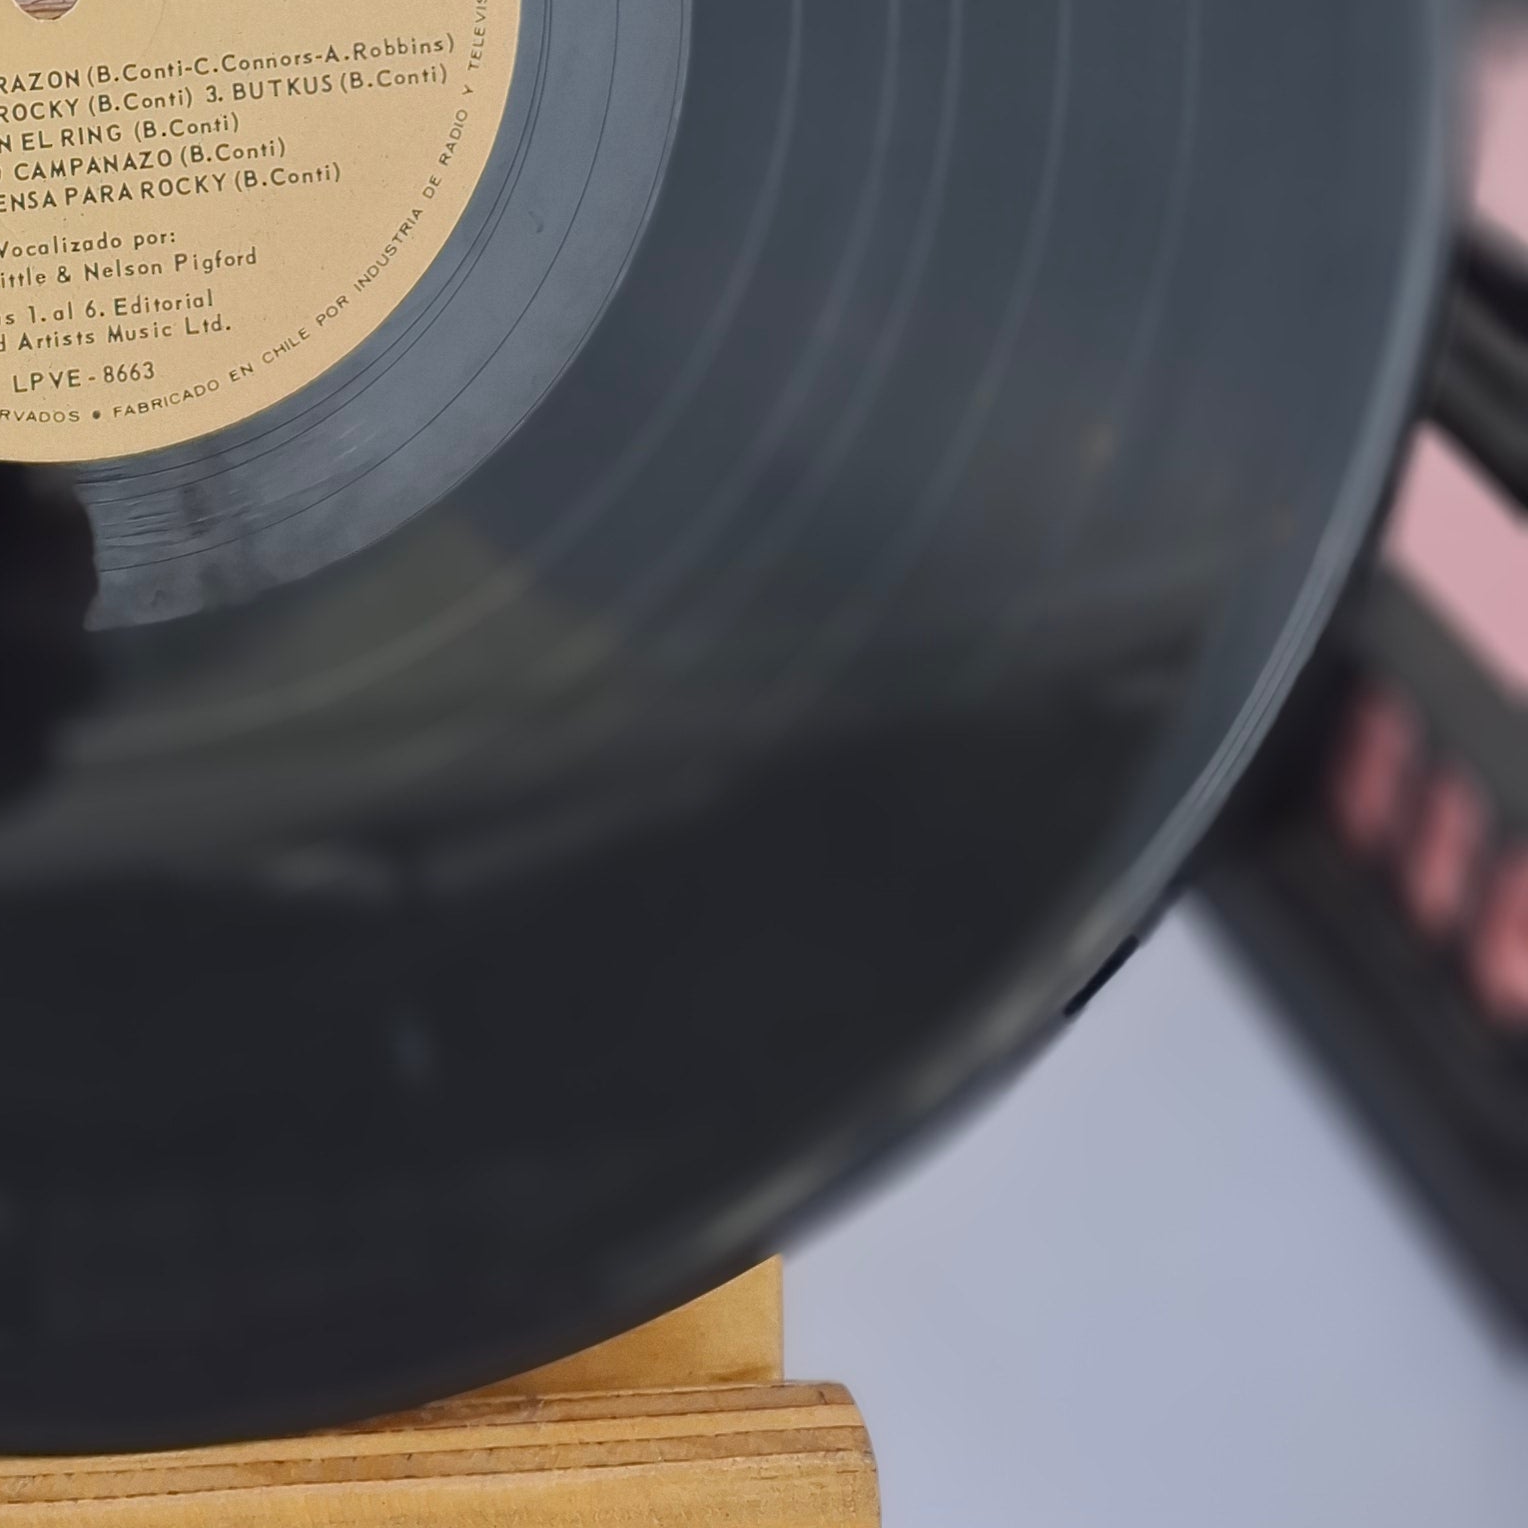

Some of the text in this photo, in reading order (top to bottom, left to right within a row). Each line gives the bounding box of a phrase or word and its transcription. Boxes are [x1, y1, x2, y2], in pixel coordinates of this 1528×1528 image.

[233, 74, 333, 100] BUTKUS
[22, 130, 52, 151] EL
[61, 124, 121, 147] RING
[15, 148, 172, 181] CAMPANAZO
[65, 182, 133, 205] PARA
[141, 173, 227, 199] ROCKY
[113, 379, 219, 418] FABRICADO
[229, 363, 254, 382] EN
[262, 327, 311, 364] CHILE
[315, 295, 349, 326] POR
[353, 206, 423, 292] INDUSTRIA
[422, 174, 442, 199] DE
[438, 108, 469, 166] RADIO
[461, 84, 474, 96] Y
[134, 231, 175, 250] por:
[57, 266, 71, 283] &
[84, 259, 162, 282] Nelson
[174, 247, 256, 273] Pigford
[114, 288, 213, 316] Editorial
[18, 331, 95, 350] Artists
[108, 323, 172, 343] Music
[185, 314, 231, 335] Ltd.
